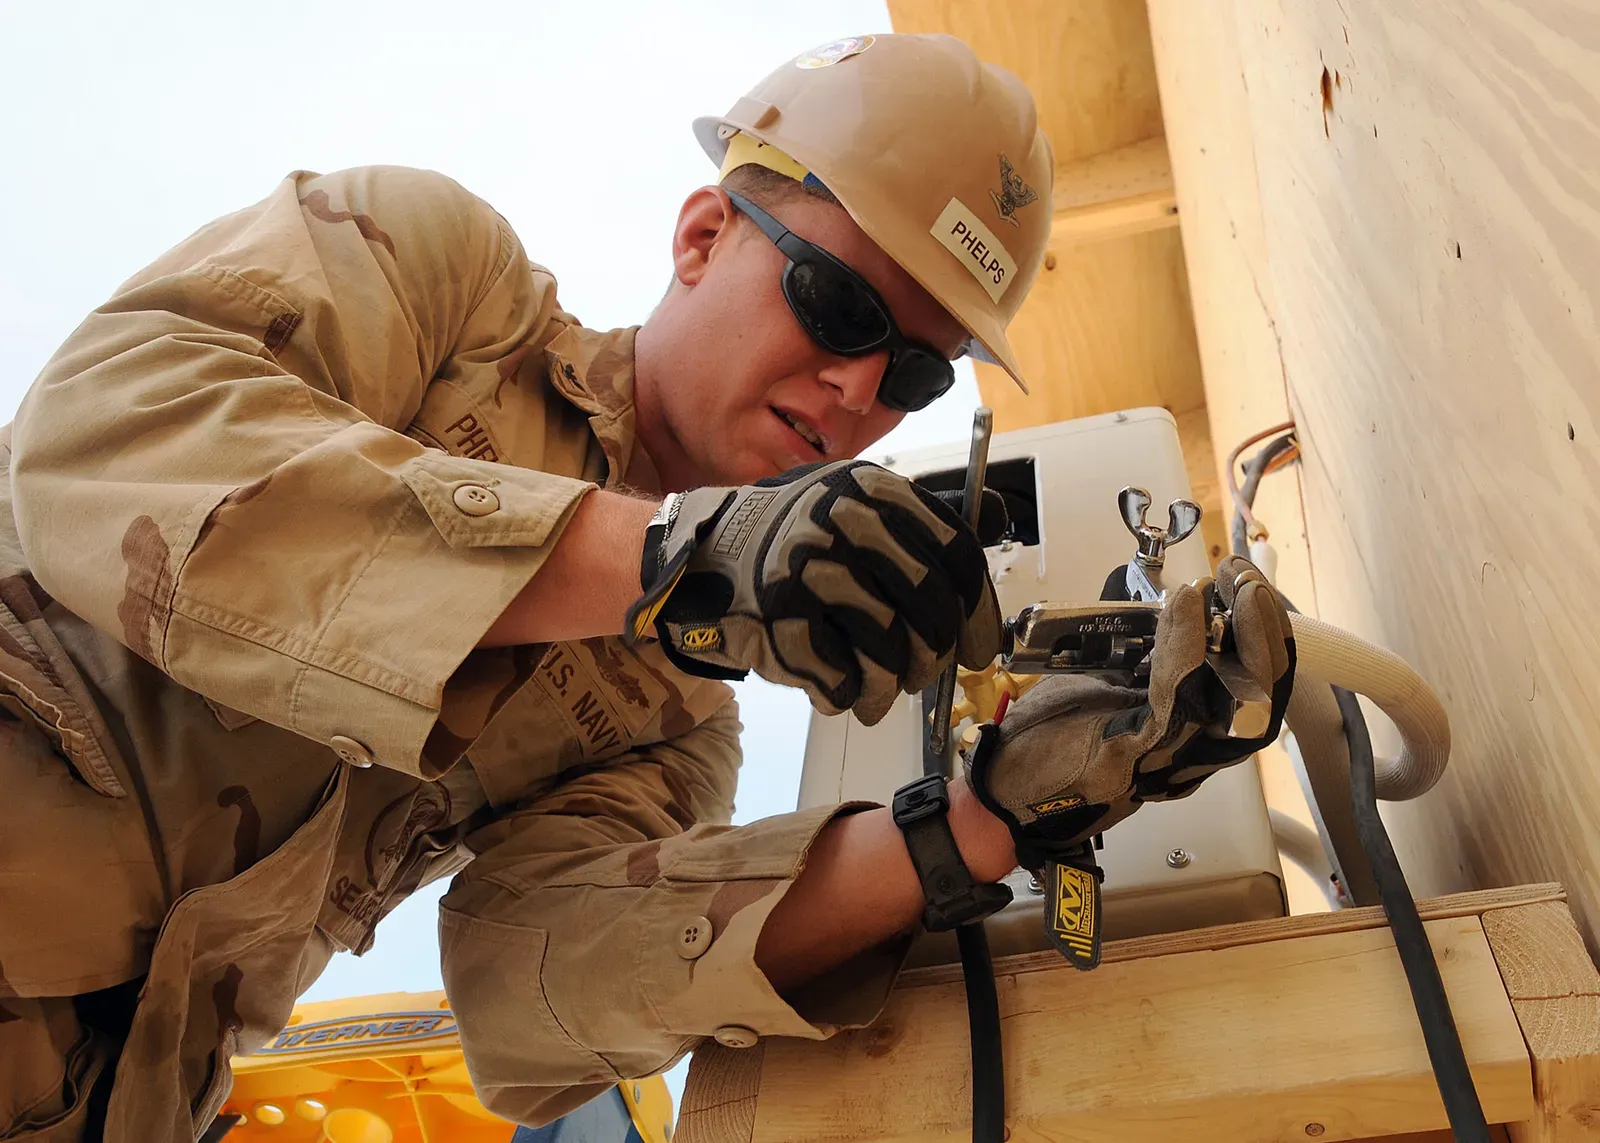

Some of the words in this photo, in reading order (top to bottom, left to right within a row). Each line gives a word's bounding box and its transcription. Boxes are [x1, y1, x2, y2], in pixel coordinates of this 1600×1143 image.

[951, 221, 1005, 284] PHELPS
[444, 413, 499, 462] PHE
[571, 690, 620, 755] NAVY
[272, 1016, 443, 1047] WERNER
